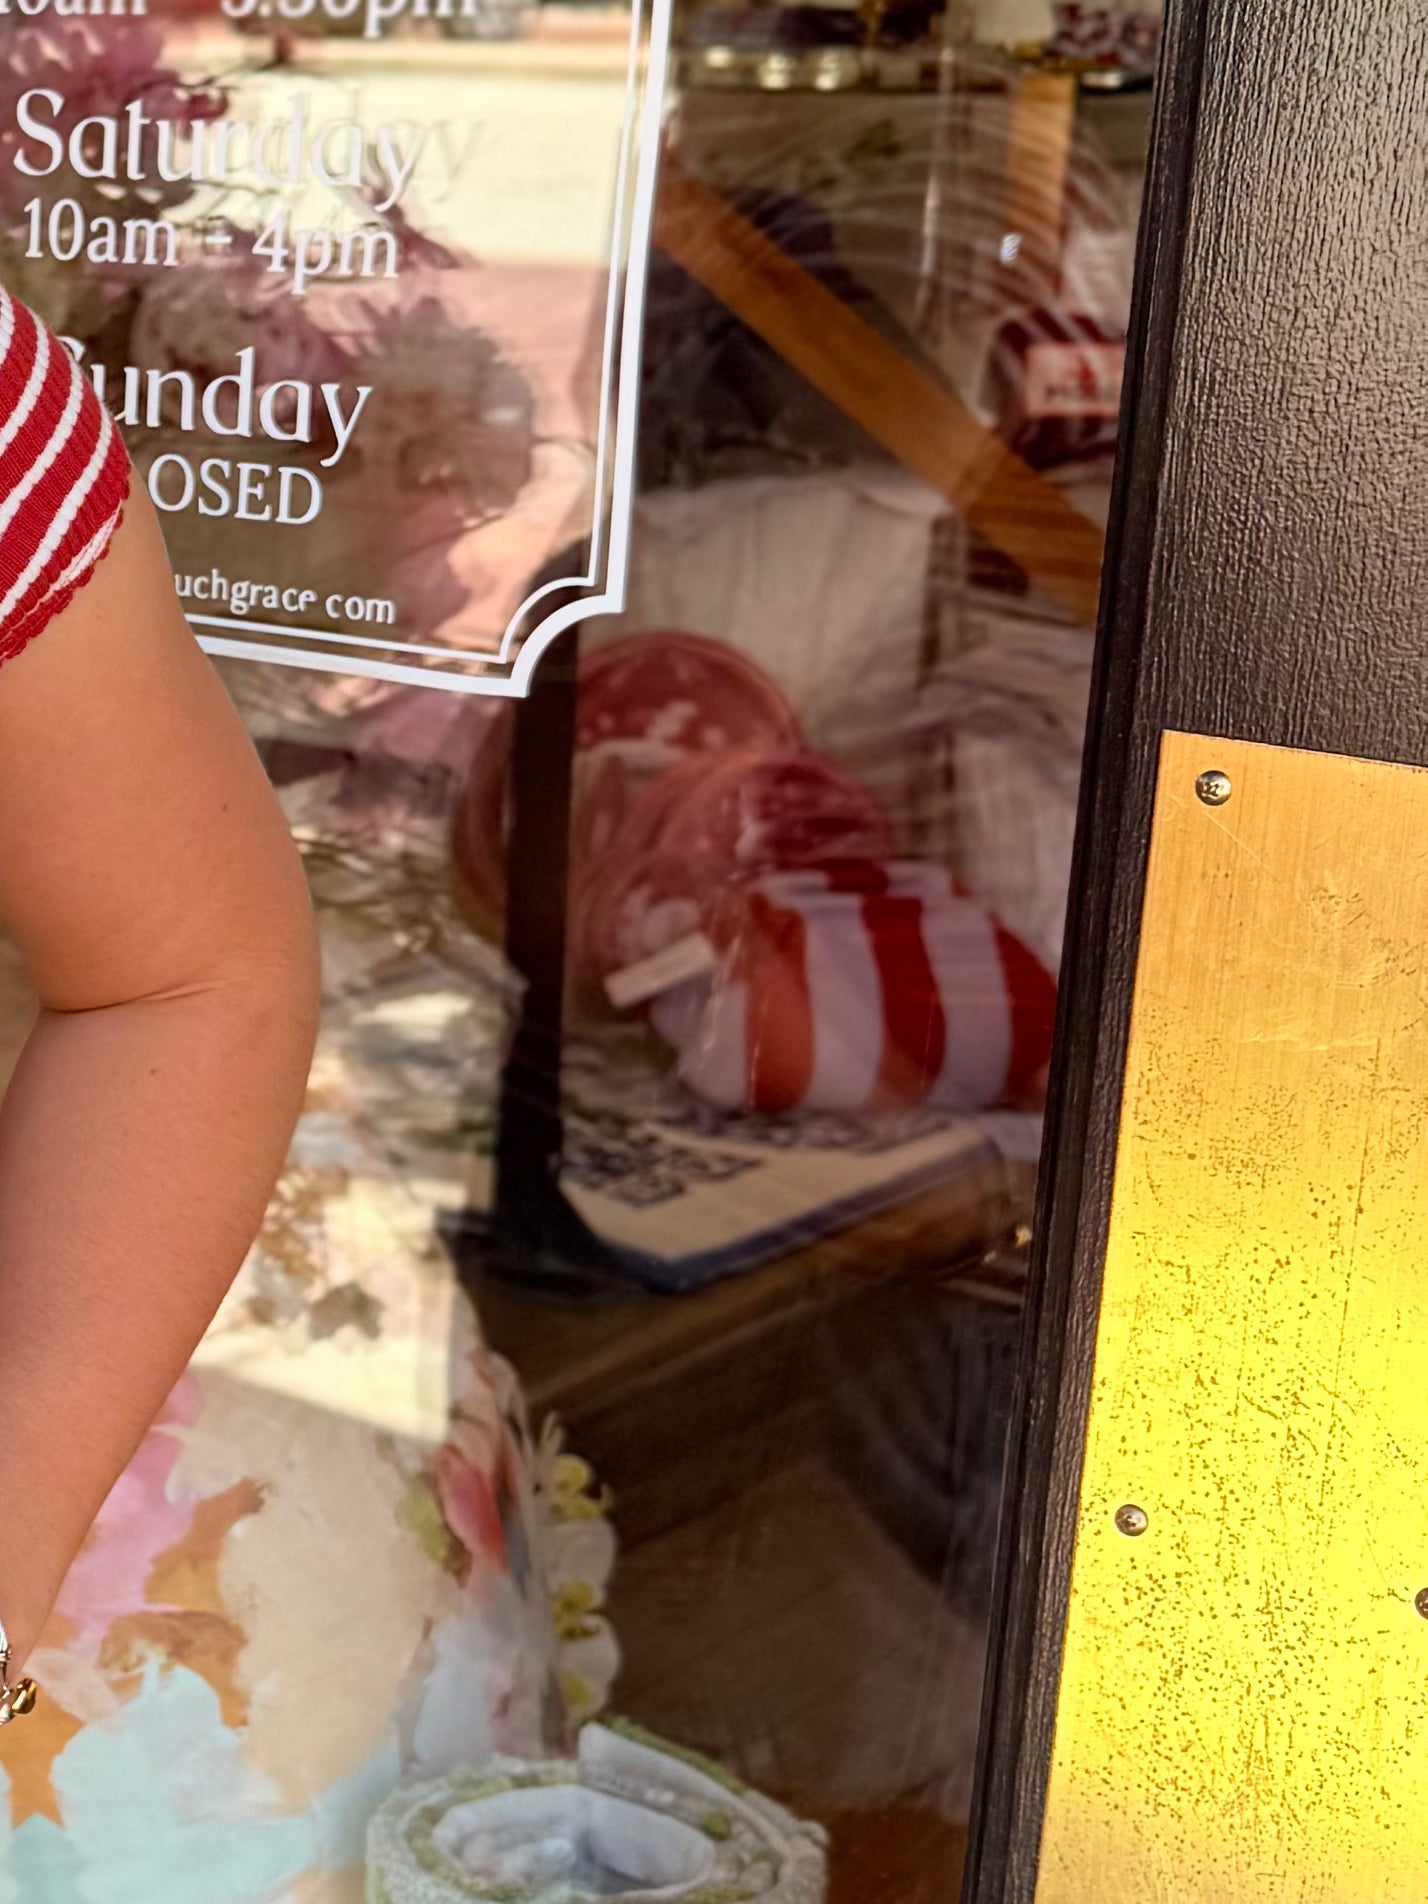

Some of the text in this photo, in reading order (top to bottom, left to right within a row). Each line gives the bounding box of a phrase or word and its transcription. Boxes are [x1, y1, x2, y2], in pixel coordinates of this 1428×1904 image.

[12, 88, 424, 212] Saturday
[23, 197, 179, 267] 10am
[251, 207, 399, 296] 4pm
[57, 336, 374, 468] unday
[147, 452, 324, 526] OSED
